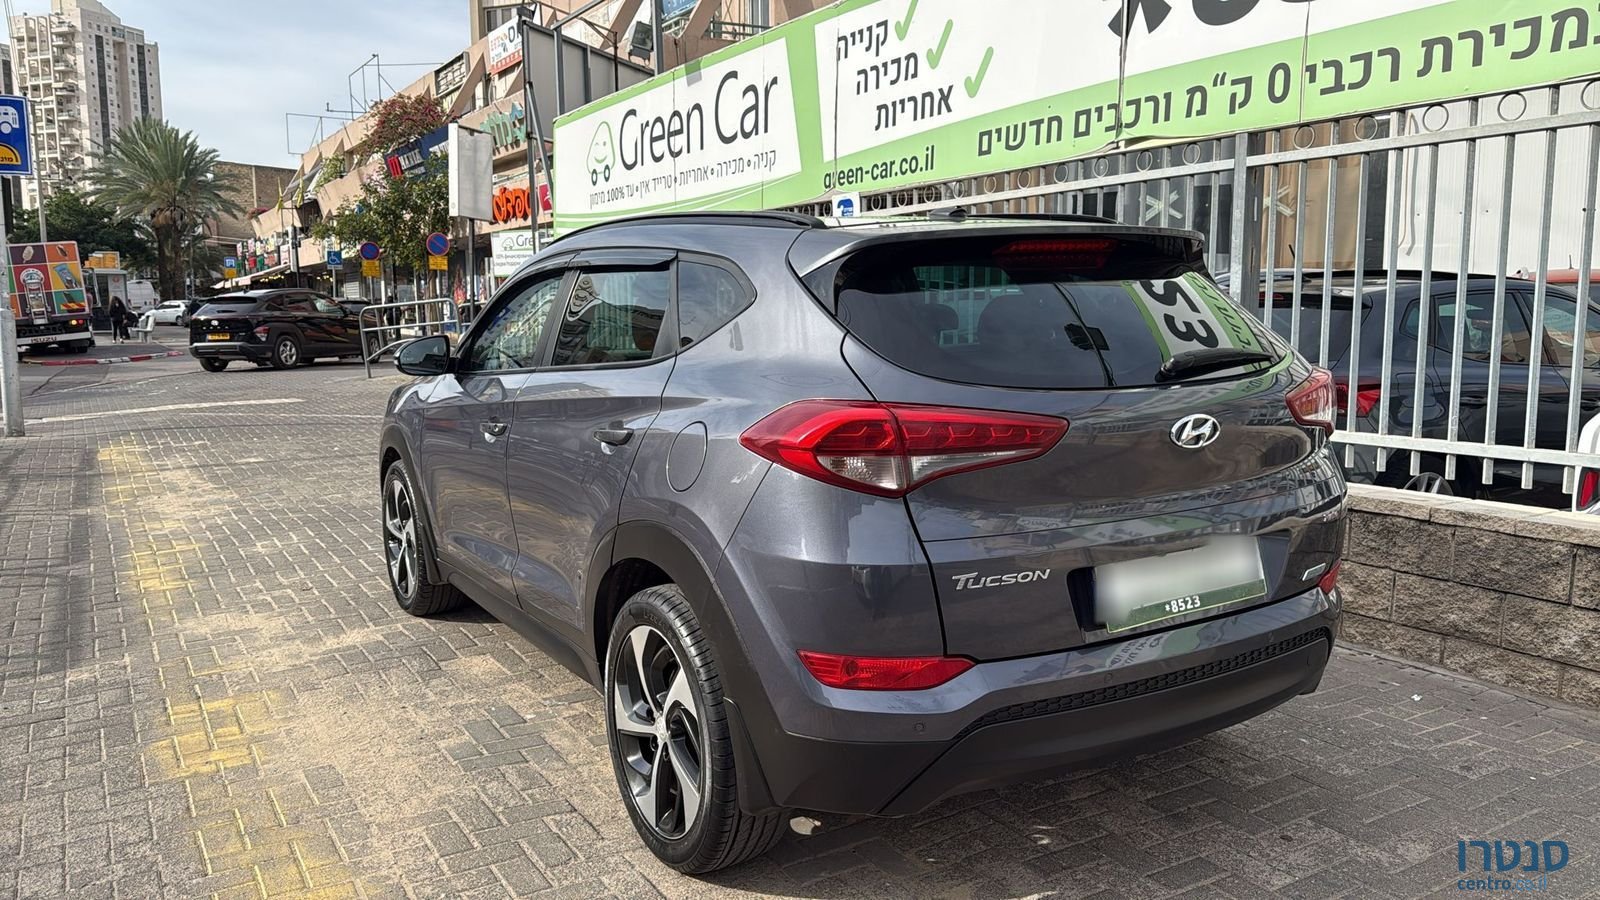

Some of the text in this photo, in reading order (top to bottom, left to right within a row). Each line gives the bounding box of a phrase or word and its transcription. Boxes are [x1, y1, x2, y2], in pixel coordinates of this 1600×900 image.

[838, 19, 888, 61] קנייה
[856, 52, 918, 95] מכירה
[1268, 62, 1290, 104] 0
[1306, 47, 1400, 96] רכבי
[620, 71, 778, 170] Green Car
[875, 85, 954, 131] אחריות
[978, 115, 1062, 156] חדשים
[679, 166, 709, 186] אחריות
[717, 160, 744, 177] מכירה
[753, 150, 776, 173] קניה
[607, 186, 624, 201] 100%
[516, 235, 533, 247] Gre
